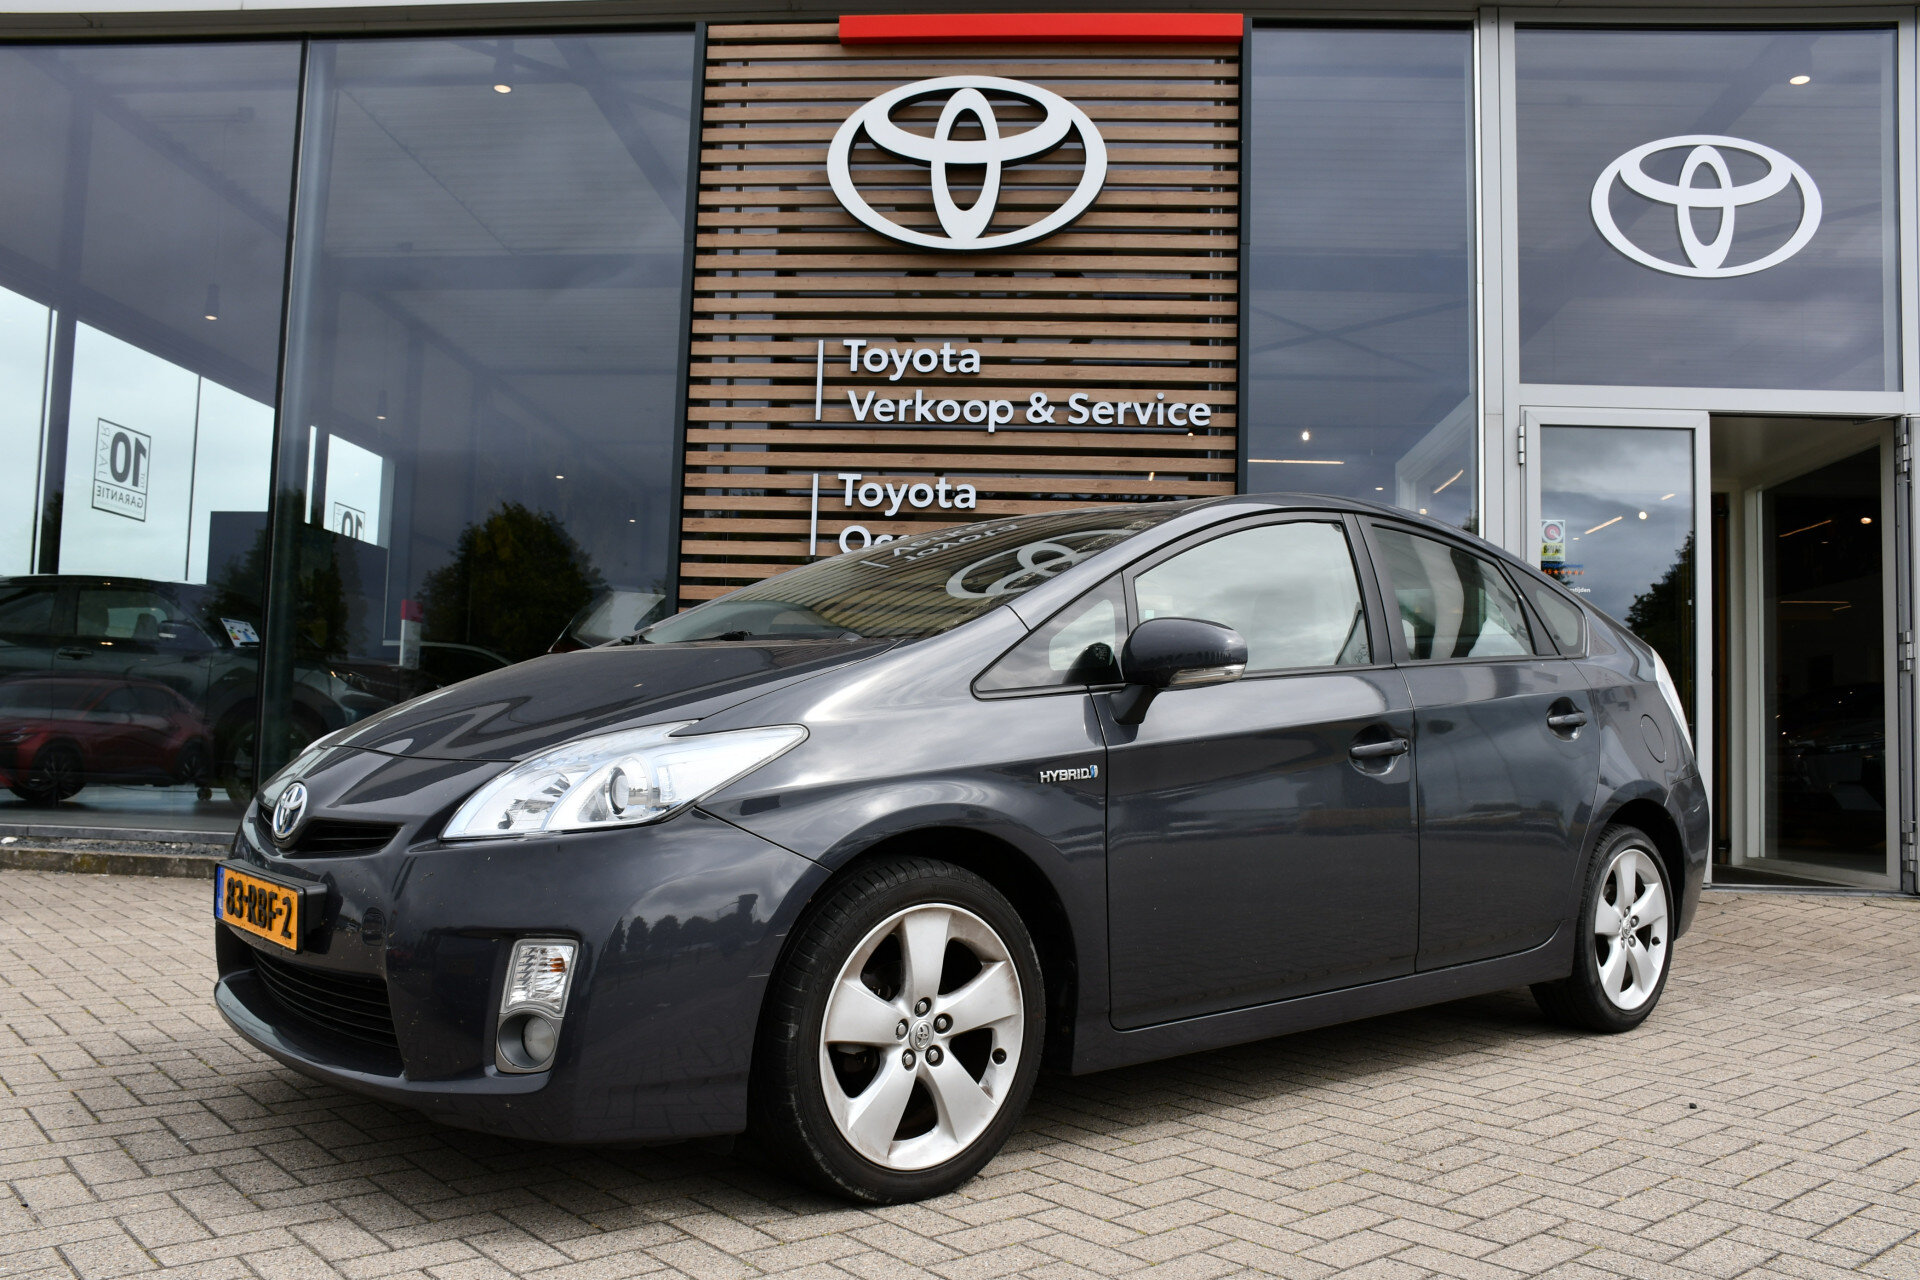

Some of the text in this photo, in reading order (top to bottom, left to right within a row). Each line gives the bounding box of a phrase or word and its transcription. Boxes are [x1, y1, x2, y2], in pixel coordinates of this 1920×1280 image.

[842, 339, 981, 382] Toyota
[847, 389, 1213, 433] Verkoop & Service
[837, 473, 977, 517] Toyota
[838, 525, 910, 554] Oc
[1040, 767, 1090, 784] HYBRID
[226, 877, 292, 939] 83-RBF-2
